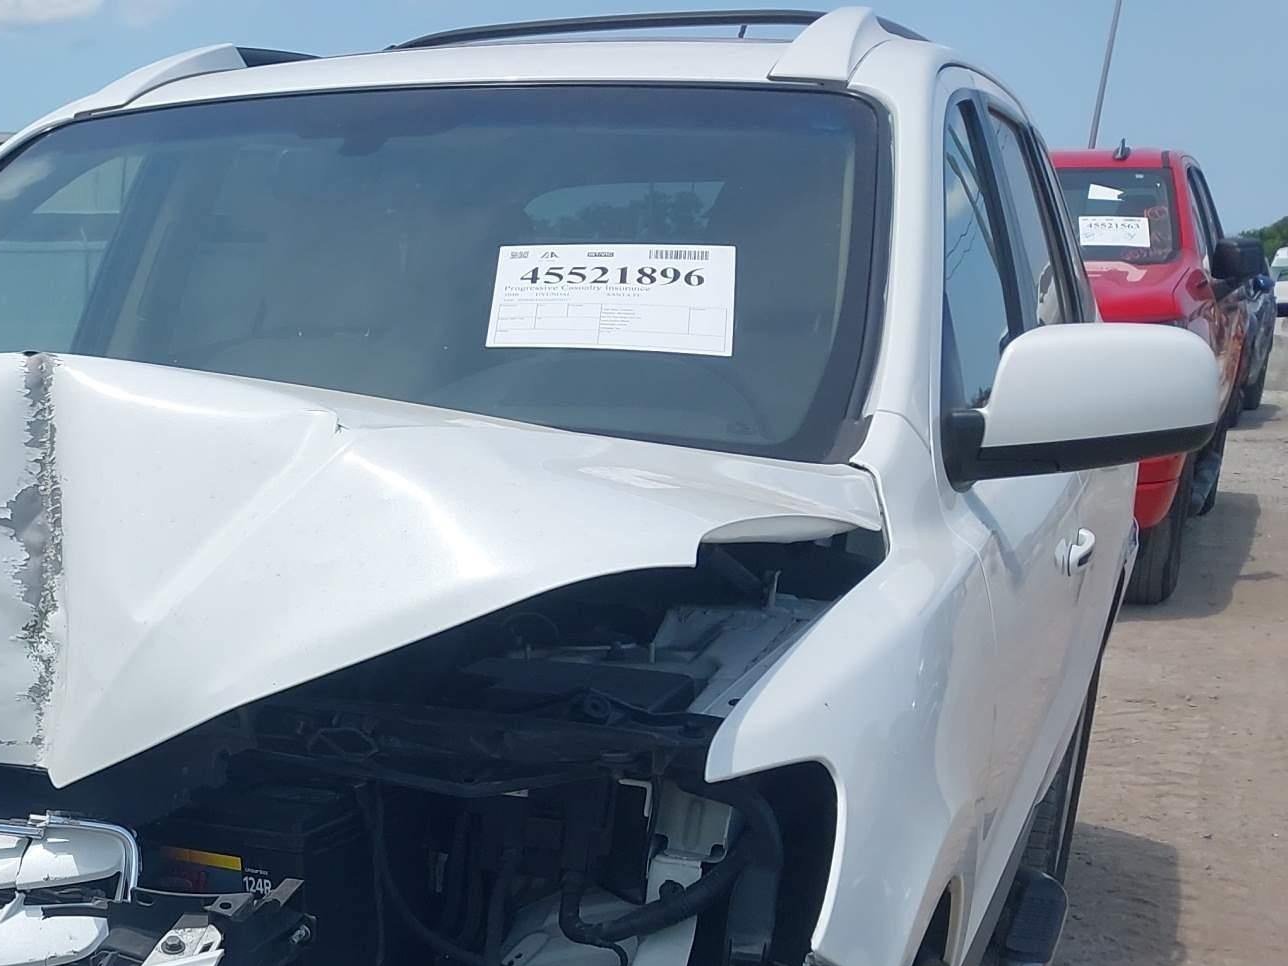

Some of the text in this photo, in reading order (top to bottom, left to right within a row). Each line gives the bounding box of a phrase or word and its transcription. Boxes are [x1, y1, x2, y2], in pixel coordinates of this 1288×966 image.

[520, 266, 705, 287] 45521896
[504, 284, 652, 293] Progressive Casualty Insurance
